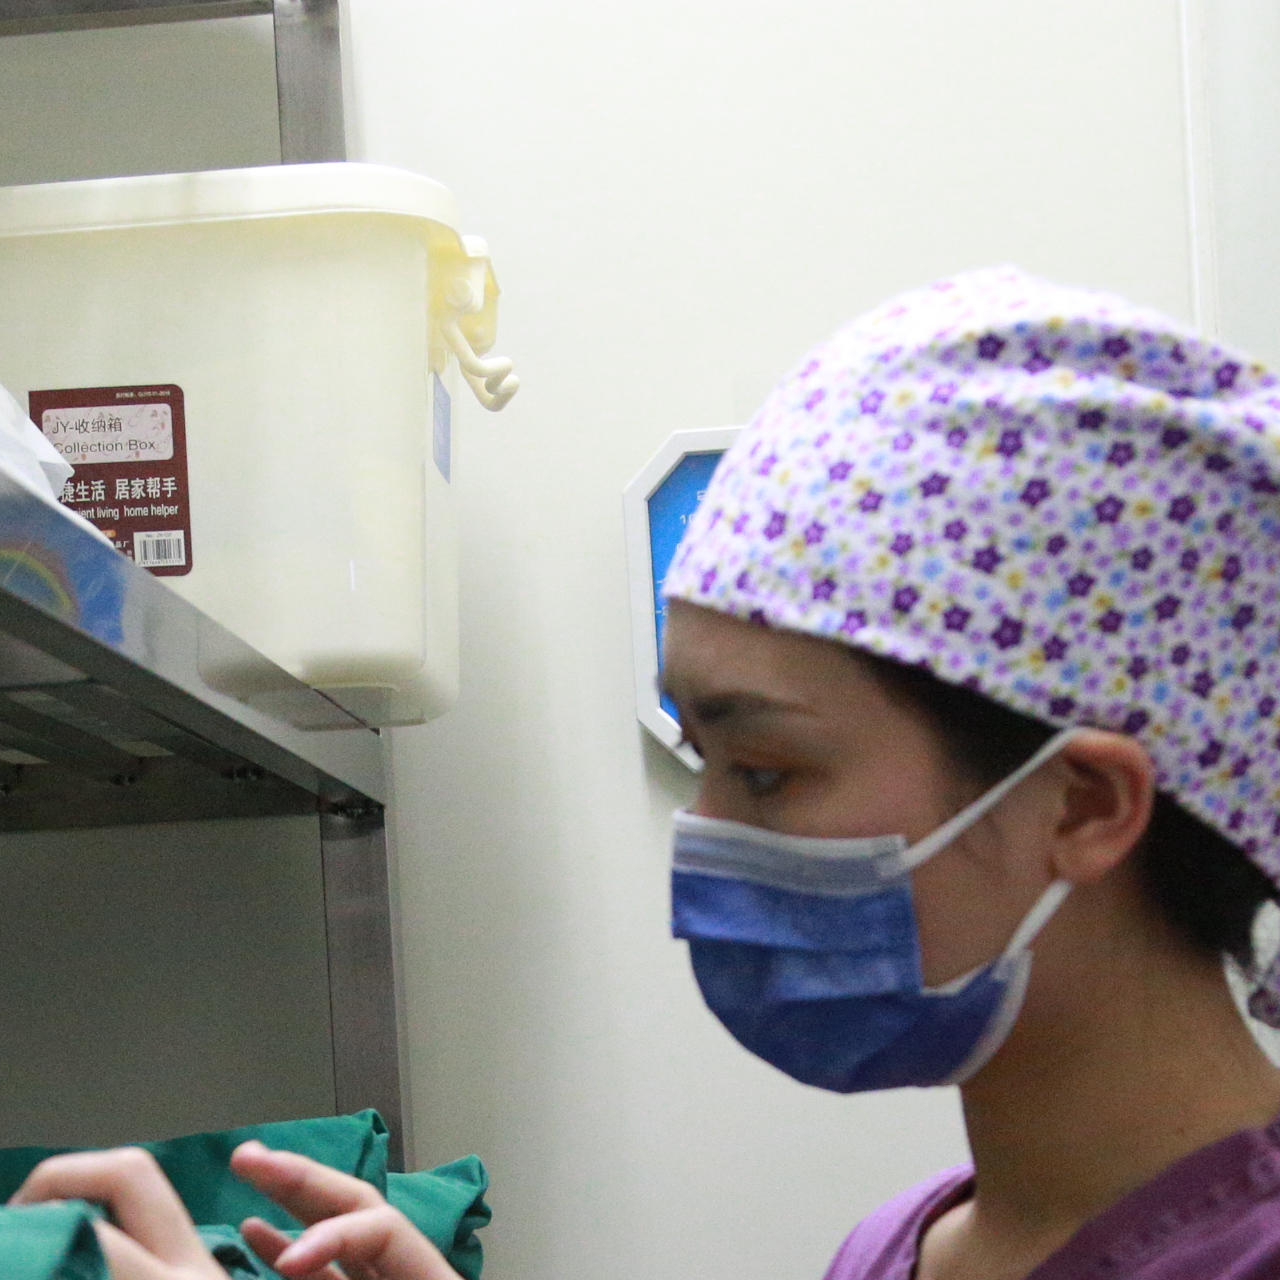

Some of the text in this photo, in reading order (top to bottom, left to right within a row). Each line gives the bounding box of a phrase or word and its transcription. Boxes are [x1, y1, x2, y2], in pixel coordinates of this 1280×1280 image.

[53, 439, 156, 454] Collection Box
[115, 477, 177, 500] 居家帮手
[96, 506, 119, 520] living
[124, 505, 148, 517] home
[150, 504, 179, 518] helper
